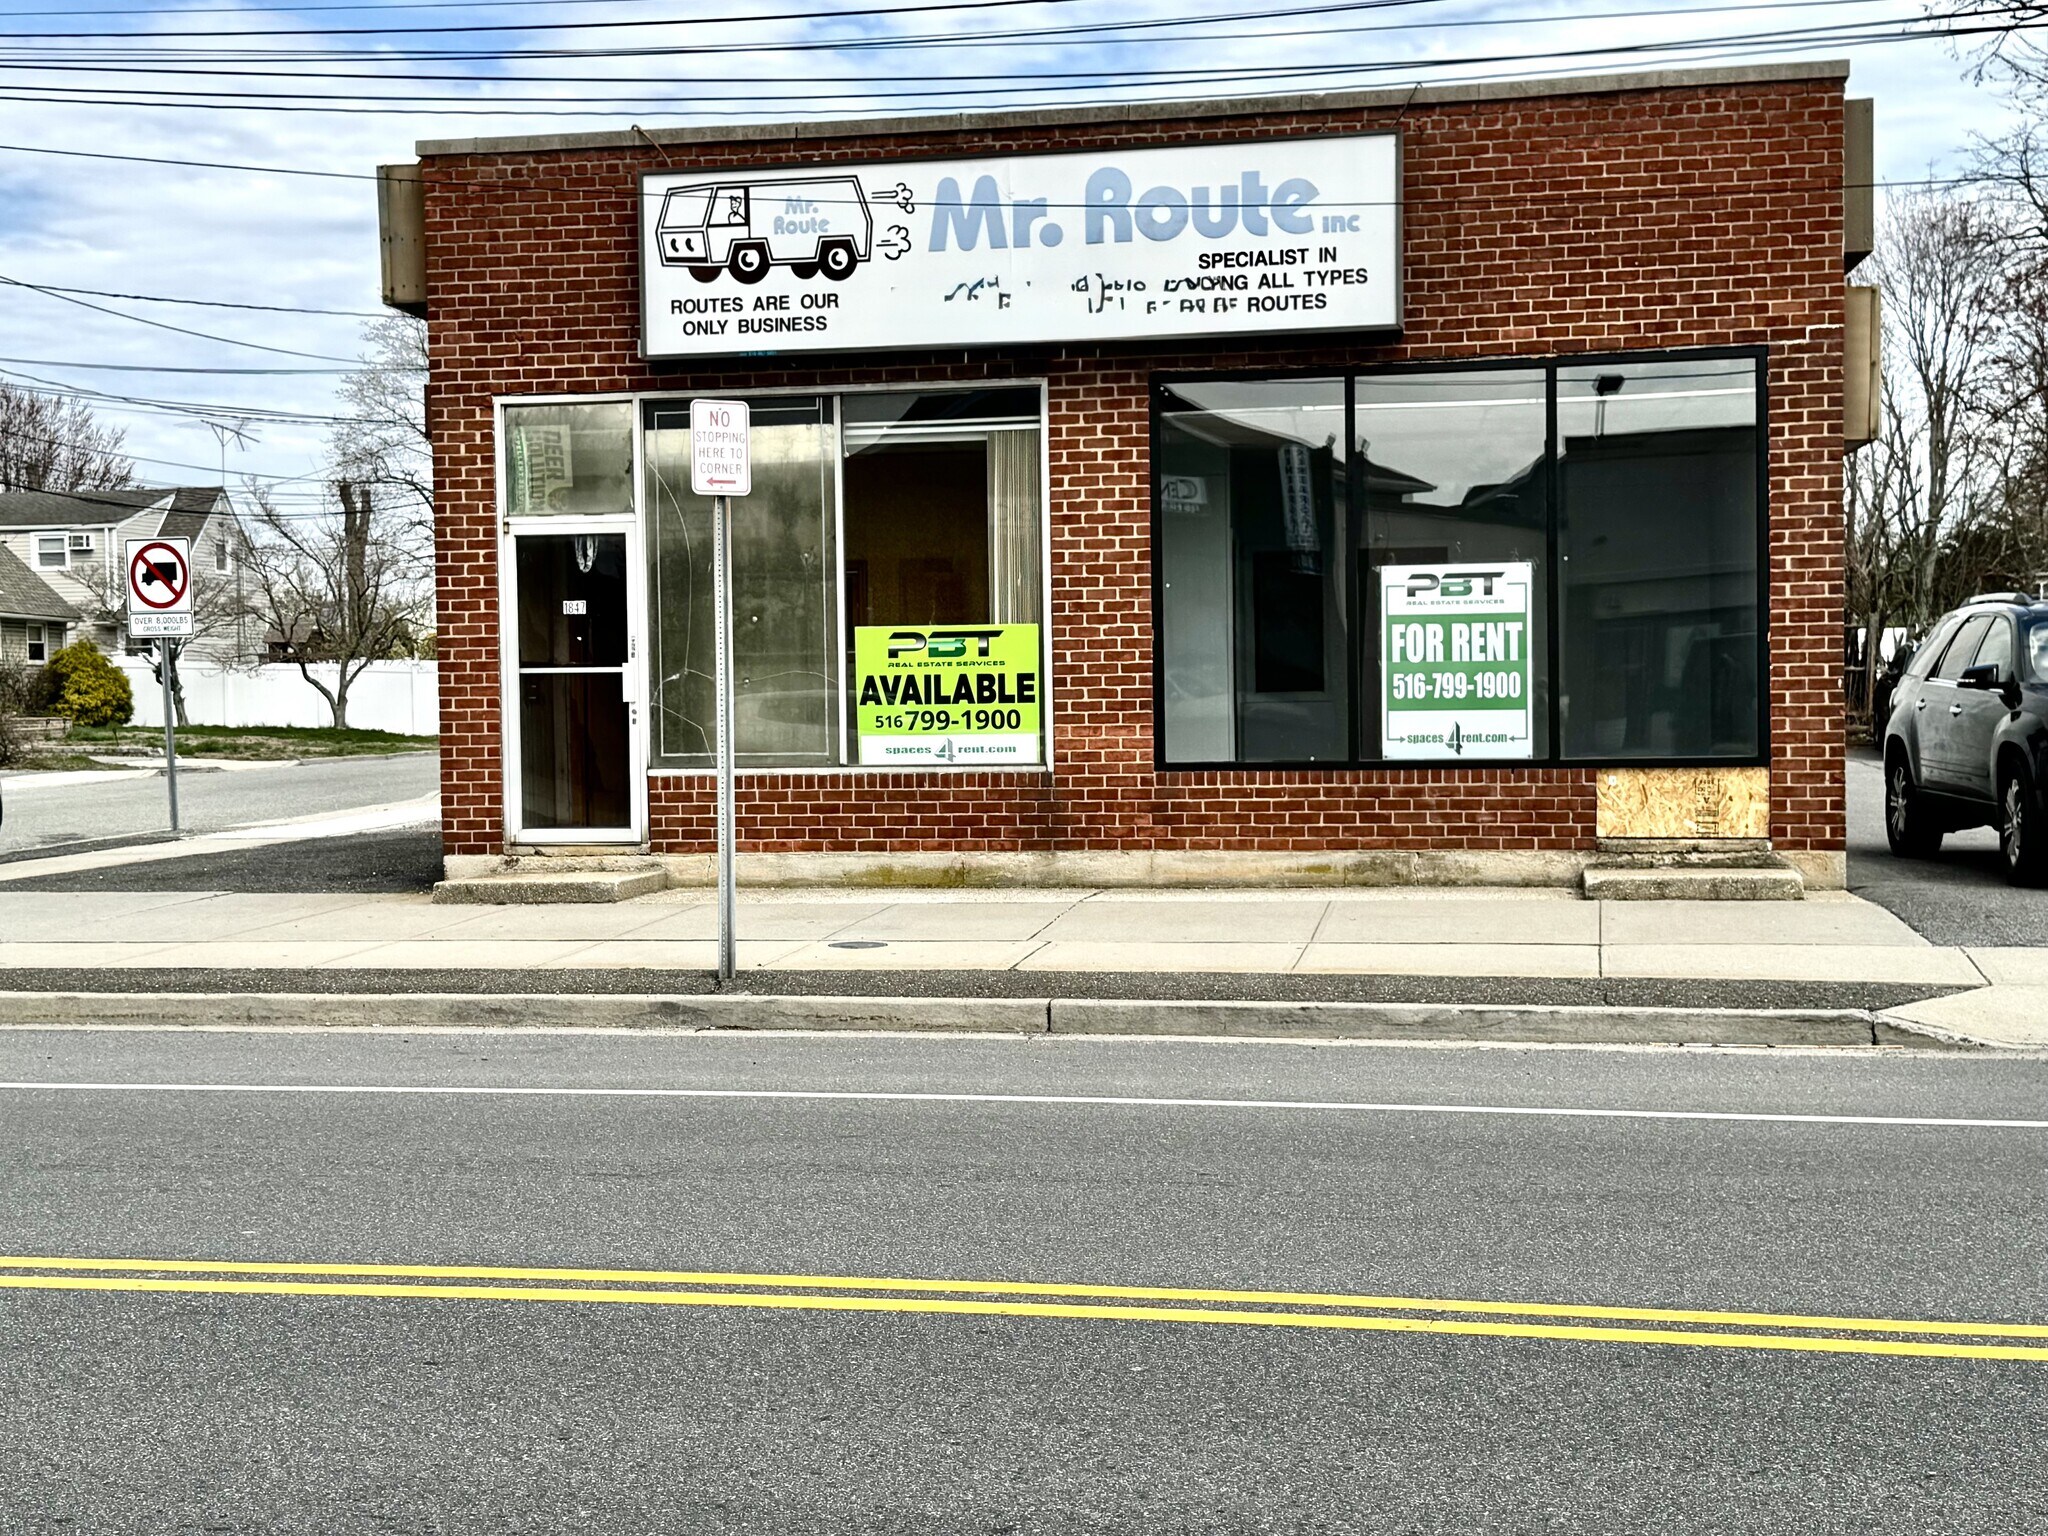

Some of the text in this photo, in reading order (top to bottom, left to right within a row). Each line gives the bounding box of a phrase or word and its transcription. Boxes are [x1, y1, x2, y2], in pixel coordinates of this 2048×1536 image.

[785, 195, 819, 215] Mr.
[928, 166, 1320, 252] Mr. Route
[774, 215, 830, 235] Route
[1199, 247, 1337, 270] SPECIALIST IN
[1258, 272, 1294, 290] ALL
[1303, 268, 1368, 287] TYPES
[671, 292, 839, 315] ROUTES ARE OUR
[1247, 293, 1328, 313] ROUTES
[682, 315, 828, 336] ONLY BUSINESS
[709, 410, 731, 428] NO
[695, 430, 746, 444] STOPPING
[698, 446, 743, 460] HERE TO
[700, 462, 742, 475] CORNER
[1406, 571, 1505, 597] PBT
[134, 616, 153, 625] OVER
[888, 629, 1004, 659] PBT
[1391, 621, 1523, 664] FOR RENT
[859, 672, 1036, 706] AVAILABLE
[1392, 670, 1522, 700] 516-799-1900
